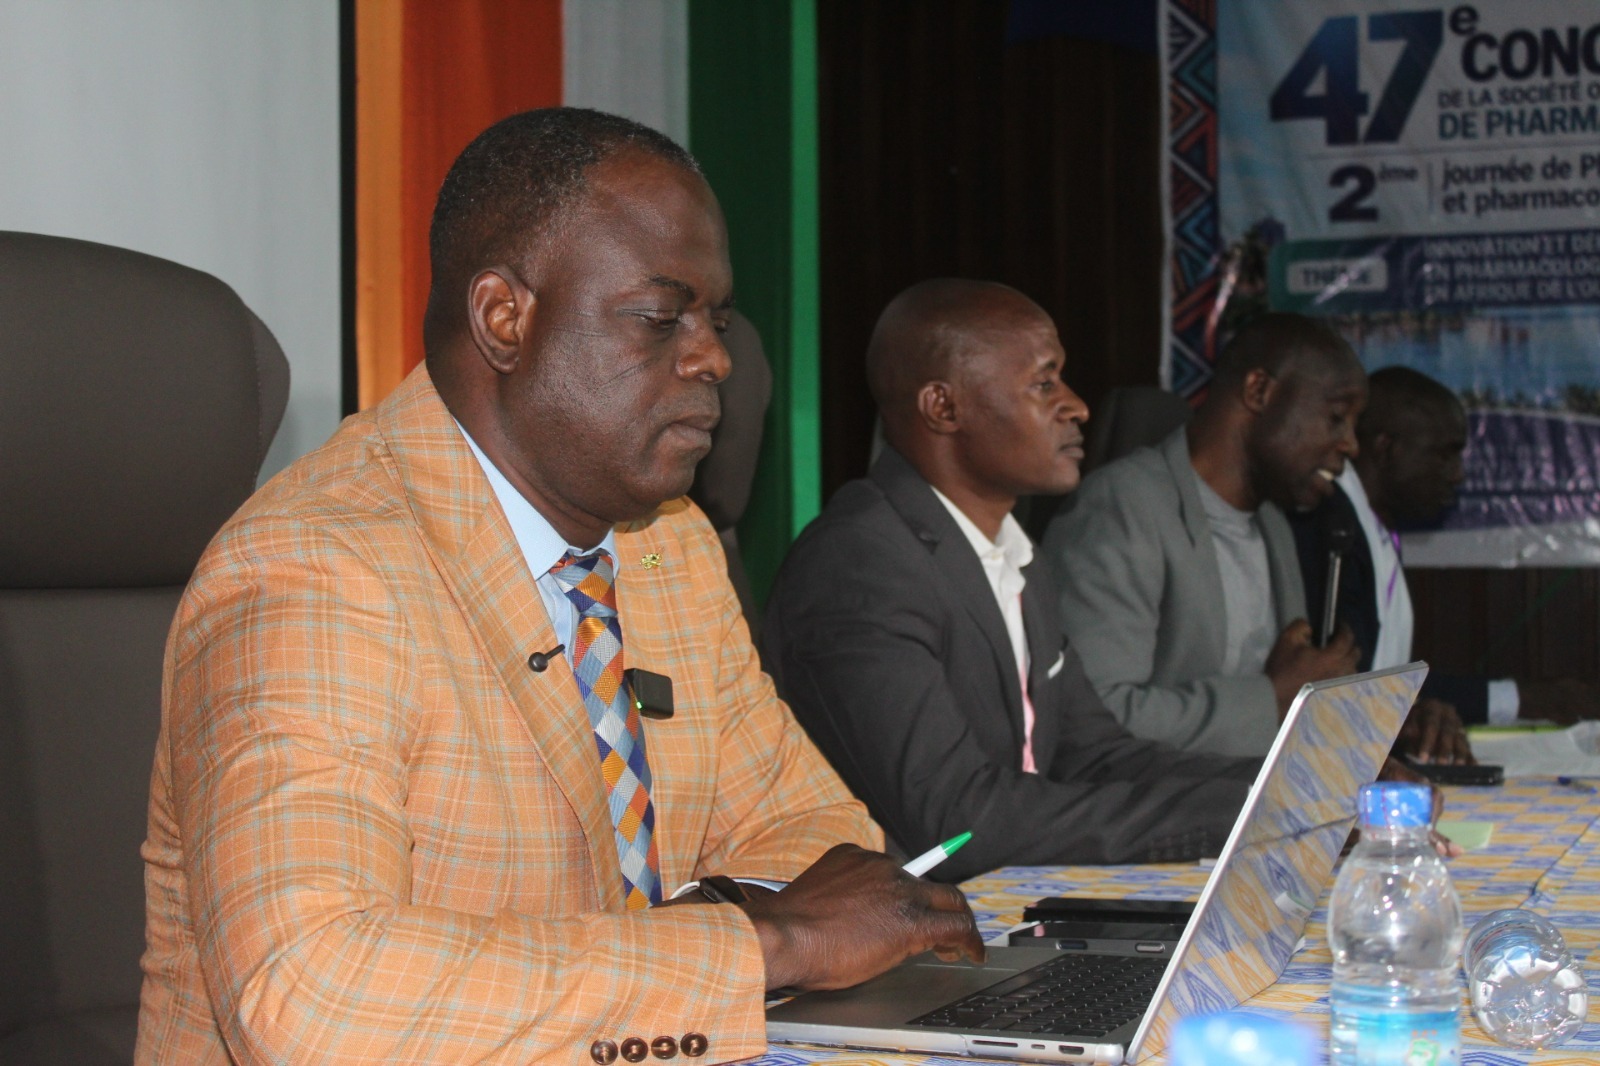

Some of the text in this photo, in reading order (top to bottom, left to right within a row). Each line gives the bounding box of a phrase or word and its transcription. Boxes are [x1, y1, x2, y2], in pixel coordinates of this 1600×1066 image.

[1439, 90, 1461, 108] DE
[1468, 88, 1491, 106] LA
[1499, 81, 1579, 105] SOCIÉTÉ
[1439, 104, 1600, 140] DE PHARM
[1442, 157, 1534, 190] journée
[1541, 155, 1571, 180] de
[1443, 185, 1600, 216] et pharmaco
[1424, 236, 1540, 257] INNOVATION
[1544, 234, 1567, 254] ET
[1537, 280, 1561, 300] DE
